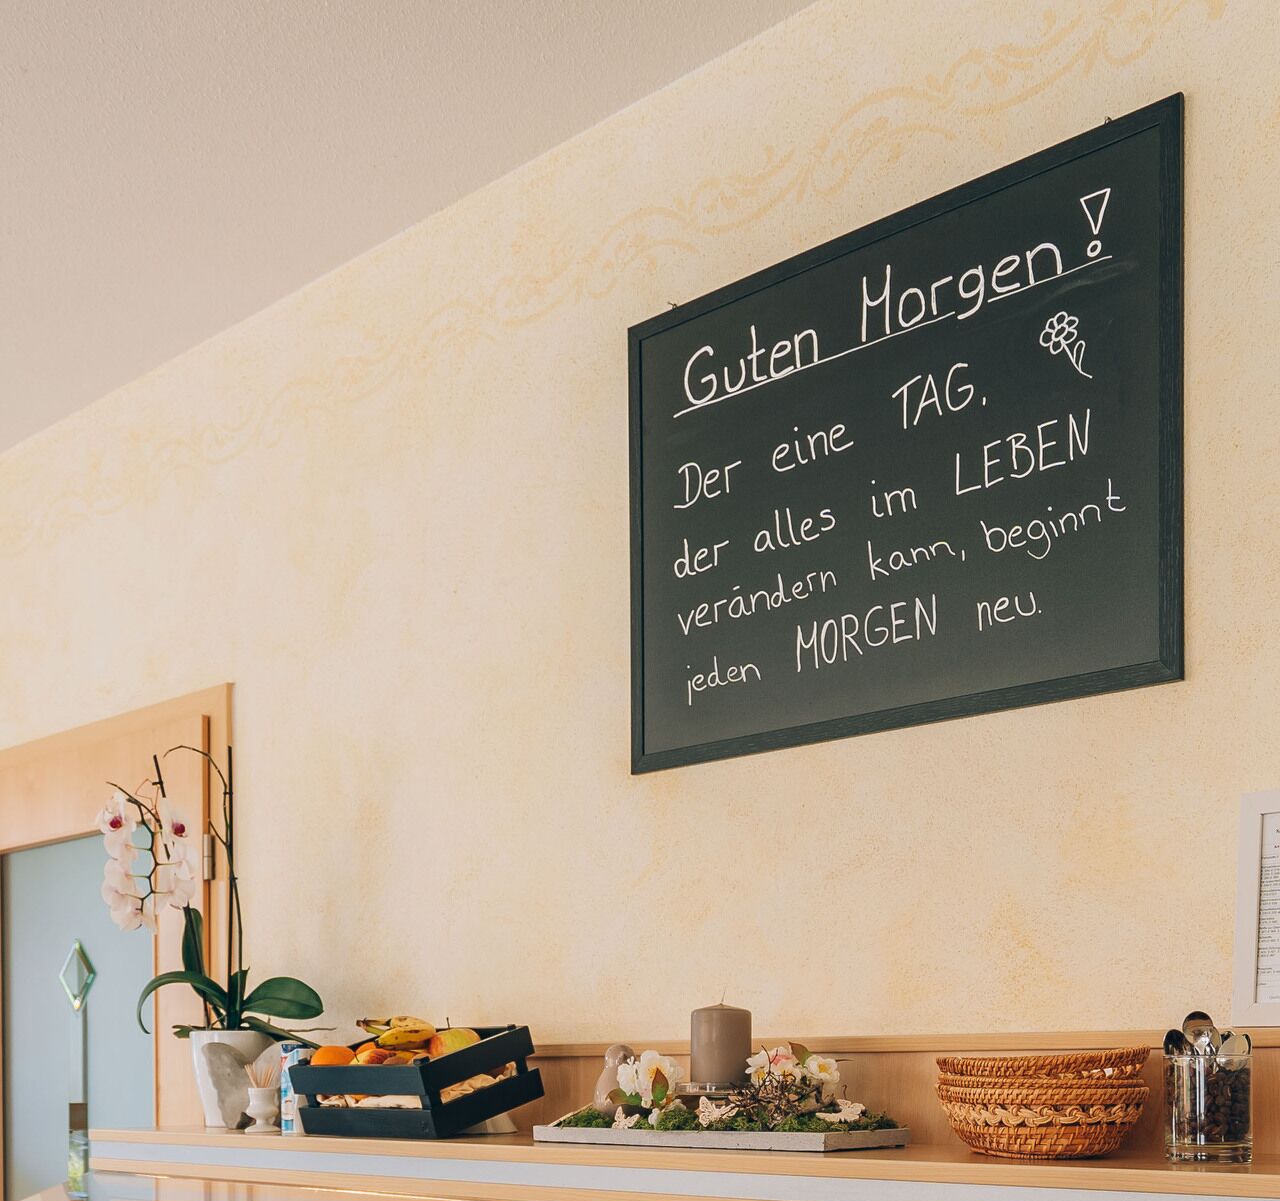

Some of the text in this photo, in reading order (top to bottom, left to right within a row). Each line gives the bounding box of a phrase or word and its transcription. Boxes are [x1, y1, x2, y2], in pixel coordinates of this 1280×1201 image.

[683, 326, 819, 404] Guten
[673, 460, 742, 510] Der
[771, 422, 854, 474] eine
[673, 408, 1091, 579] der alles im LEBEN
[867, 536, 967, 582] kann,
[981, 478, 1127, 560] beginnt
[686, 589, 1042, 706] jeden MORGEN neu.
